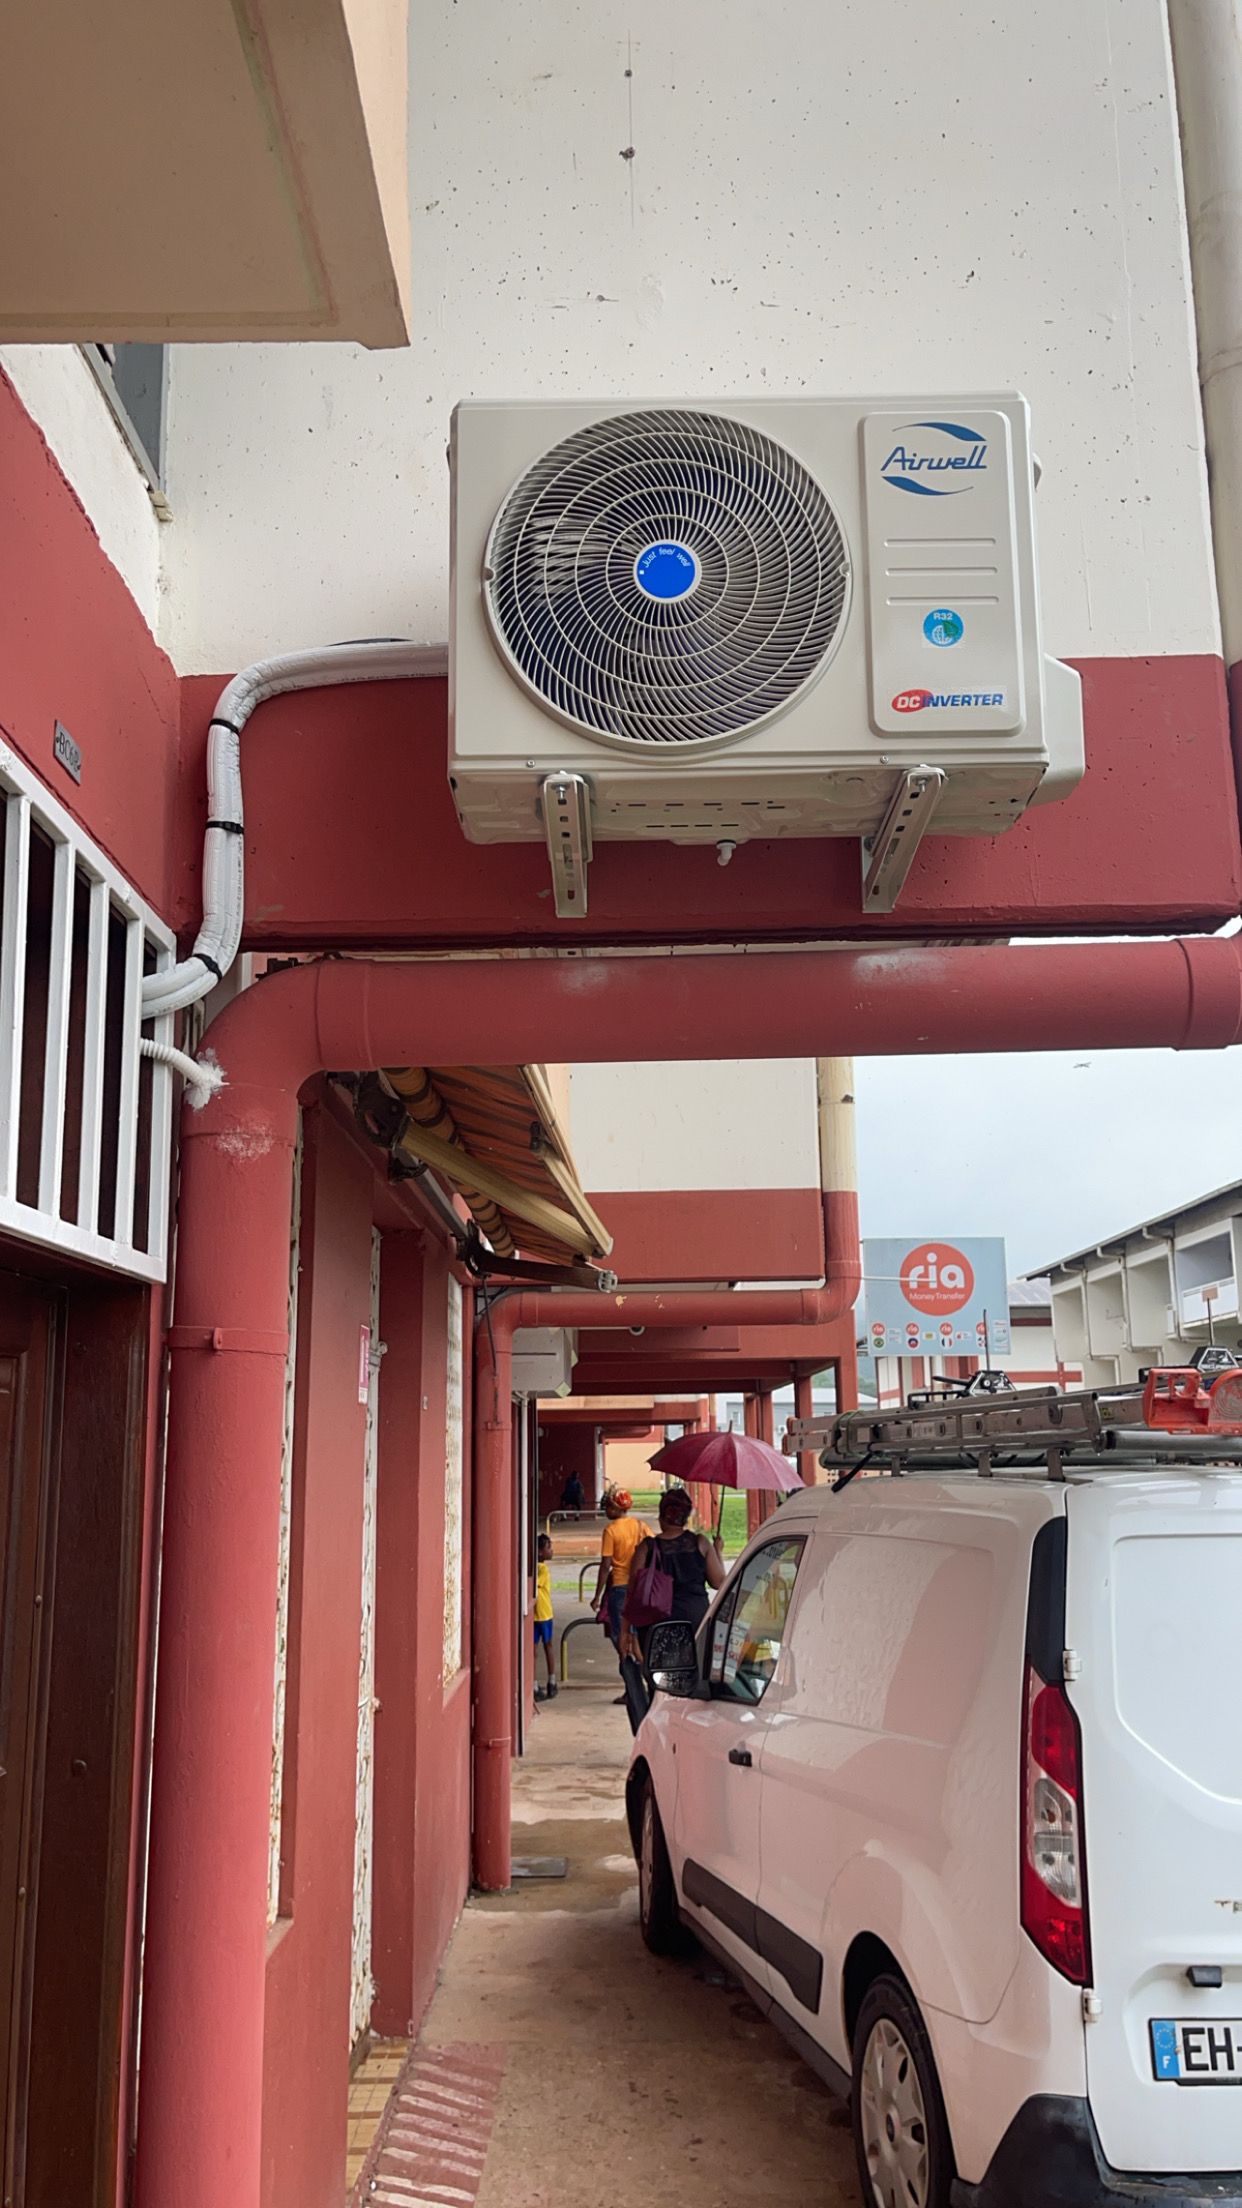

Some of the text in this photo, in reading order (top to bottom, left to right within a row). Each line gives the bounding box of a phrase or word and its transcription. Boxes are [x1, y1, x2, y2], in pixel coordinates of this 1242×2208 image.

[880, 445, 987, 471] Airwell
[933, 612, 953, 620] R32
[896, 693, 1003, 709] DC INVERTER
[909, 1252, 965, 1289] ria
[909, 1292, 966, 1302] Money Transfer
[1162, 2055, 1171, 2070] F
